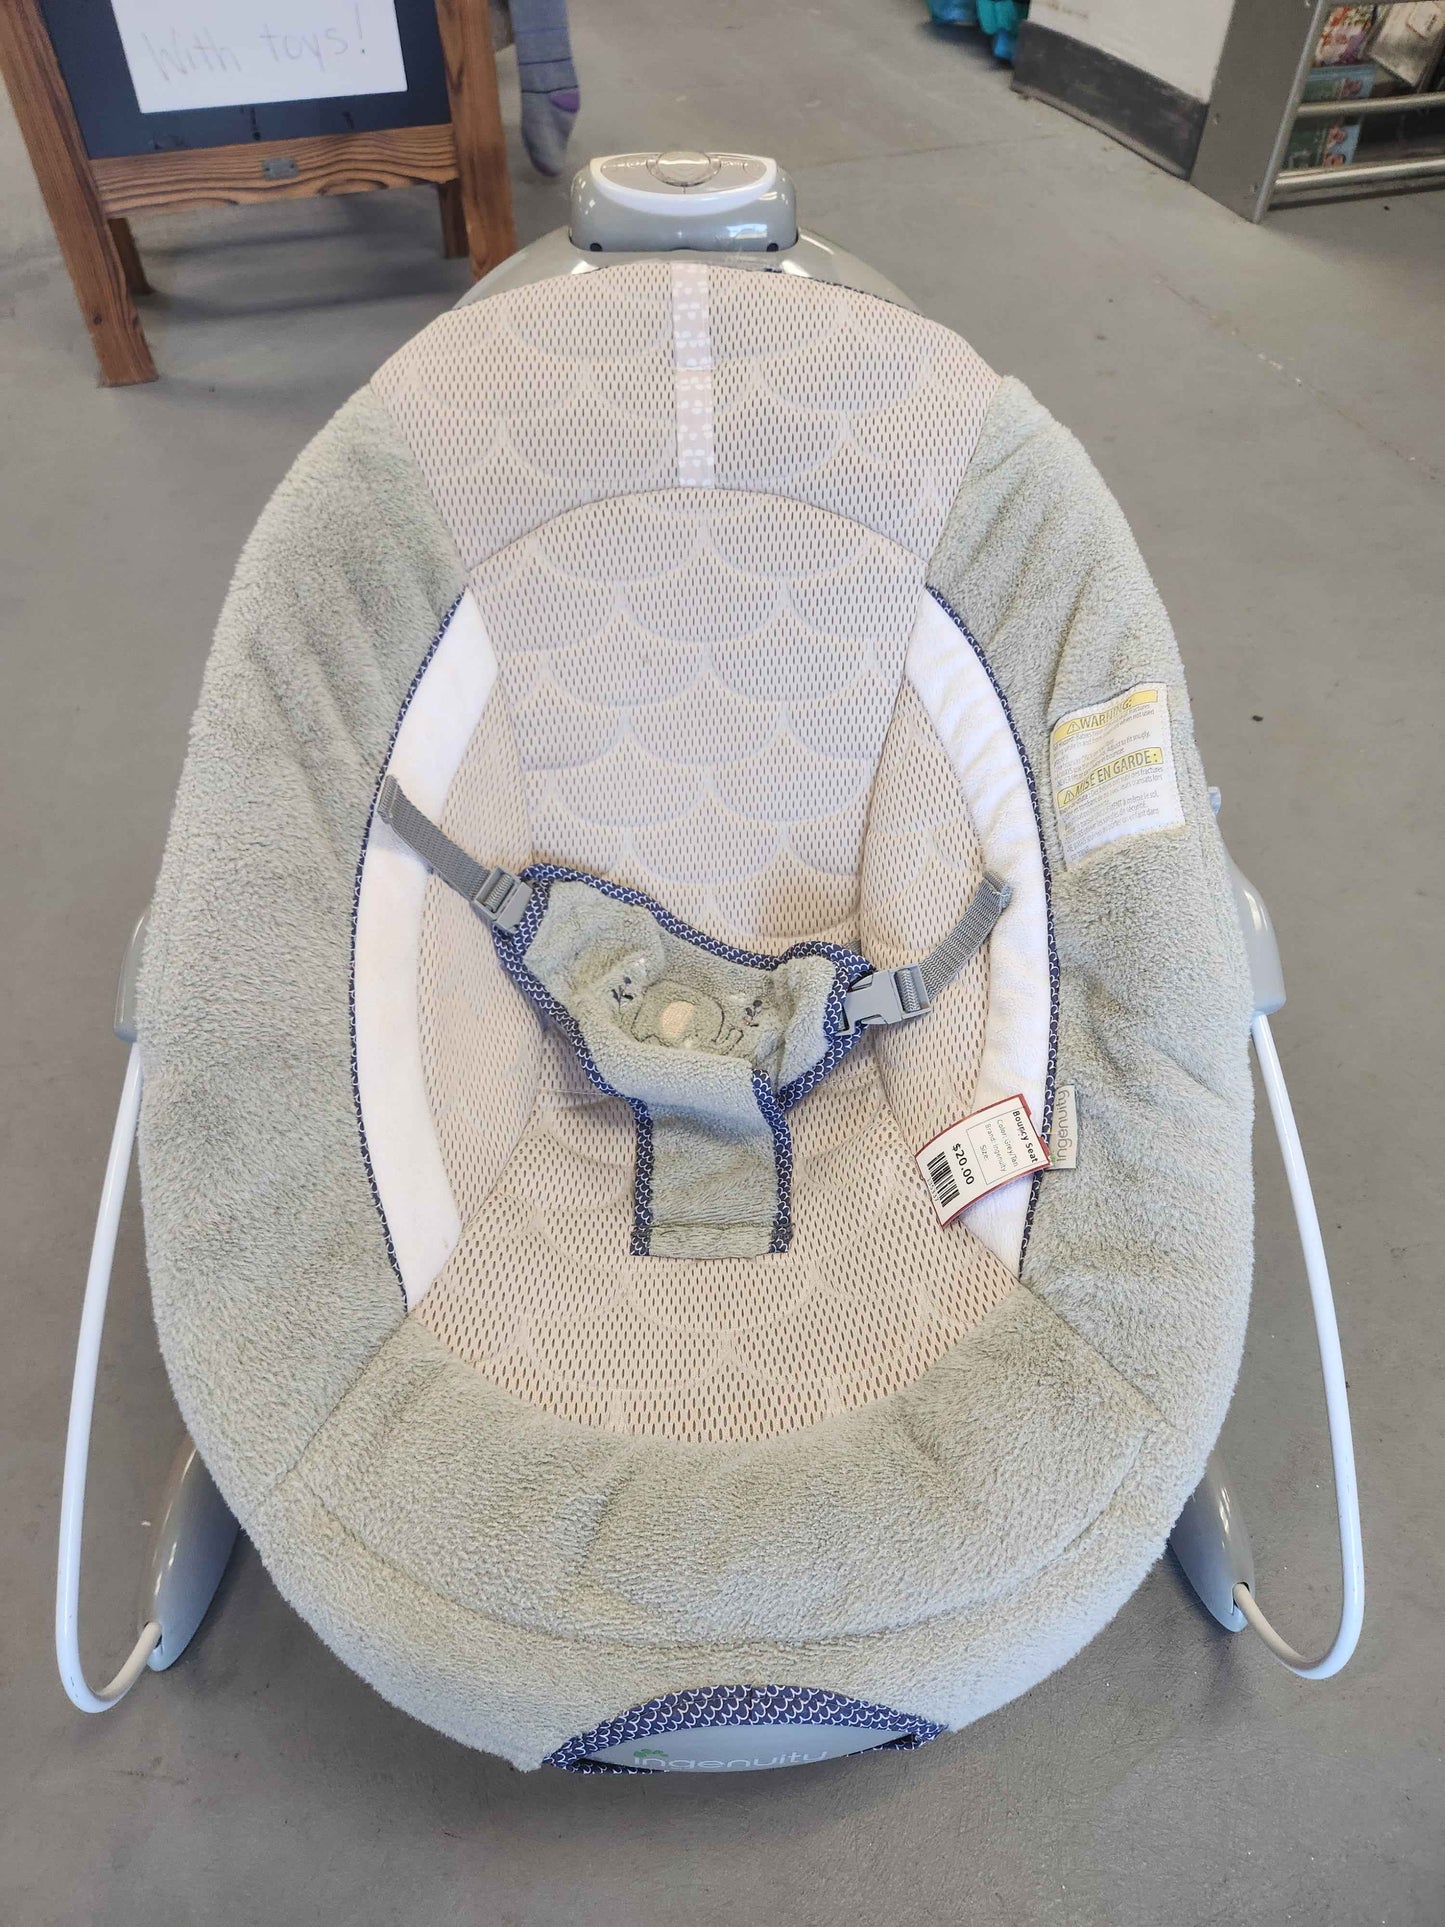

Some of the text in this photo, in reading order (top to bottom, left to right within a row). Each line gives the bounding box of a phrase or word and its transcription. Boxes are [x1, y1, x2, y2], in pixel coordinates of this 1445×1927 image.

[141, 2, 366, 82] With toys!
[1075, 772, 1096, 796] MISE
[1097, 765, 1111, 783] EN
[1012, 1110, 1039, 1163] Bouncy Seat
[1056, 1089, 1073, 1163] ingenuity
[951, 1142, 975, 1185] $20.00
